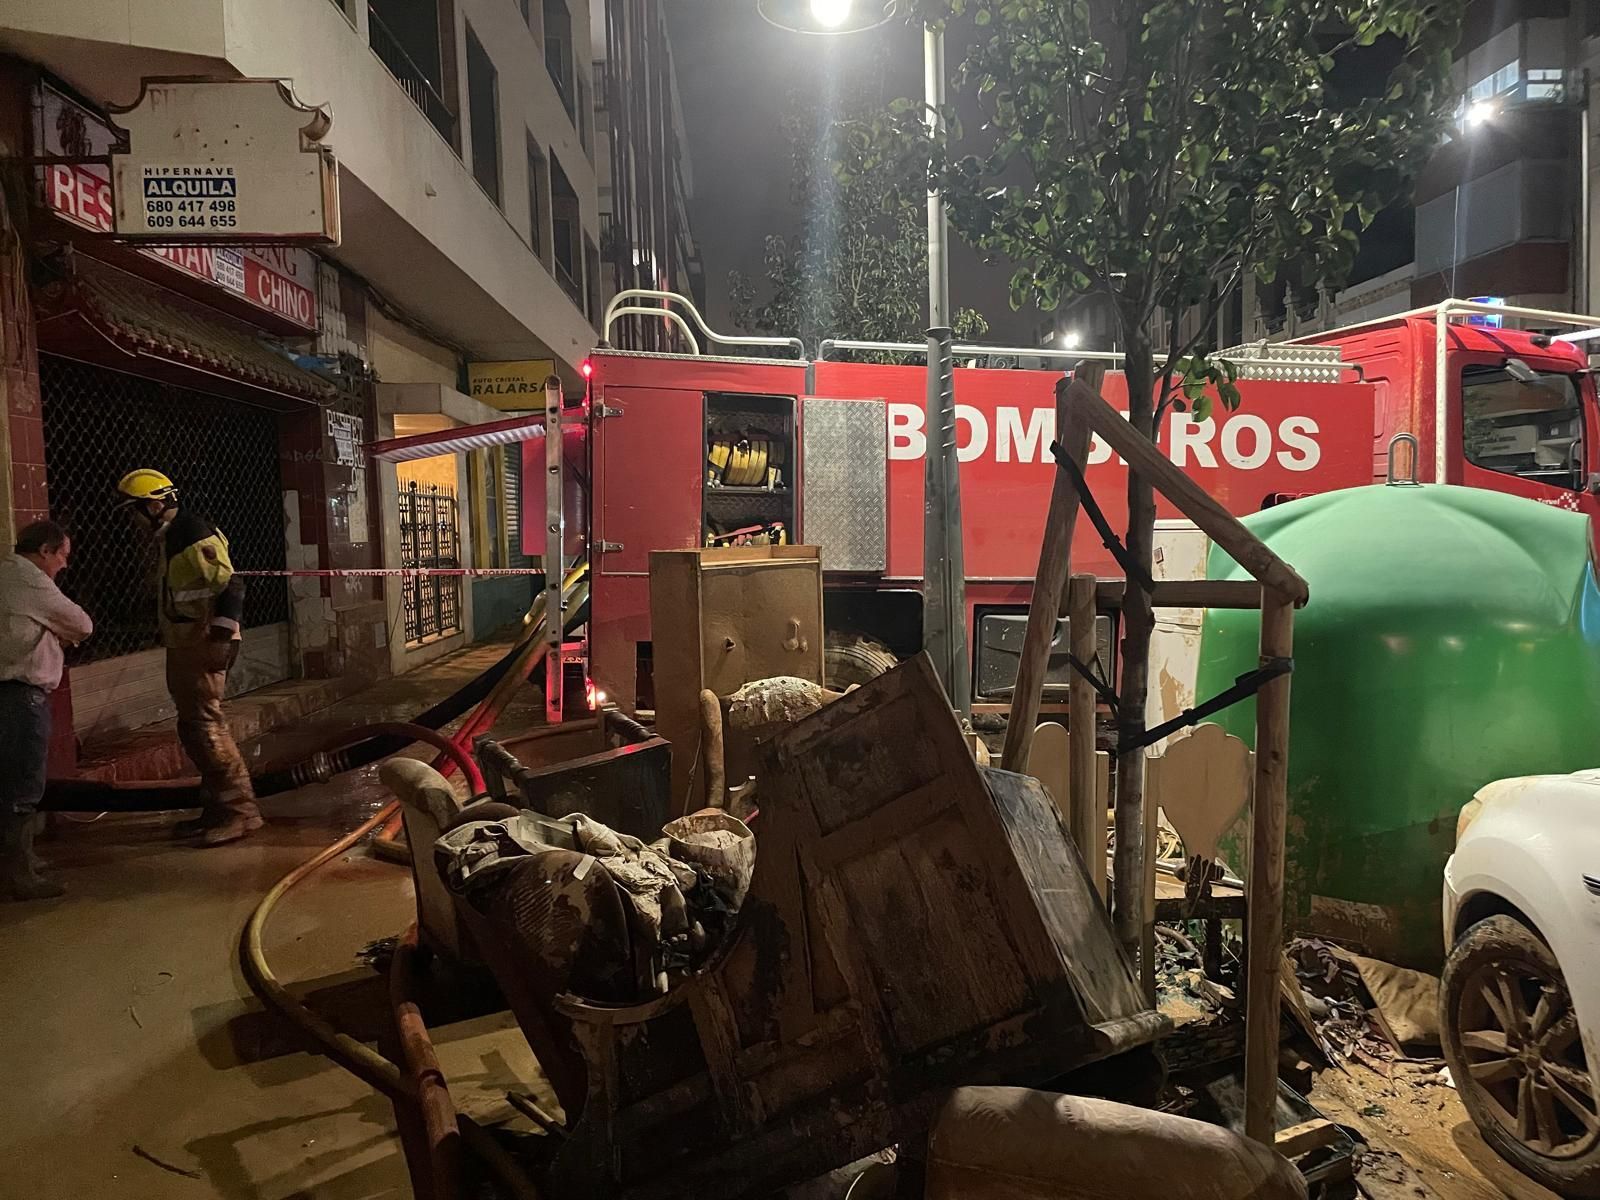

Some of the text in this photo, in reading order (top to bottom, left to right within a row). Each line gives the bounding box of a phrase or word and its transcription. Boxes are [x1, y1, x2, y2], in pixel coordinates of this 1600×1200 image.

[147, 180, 234, 196] ALQUILA
[147, 201, 236, 212] 680 417 498
[147, 216, 236, 227] 609 644 655
[258, 269, 310, 323] CHINO
